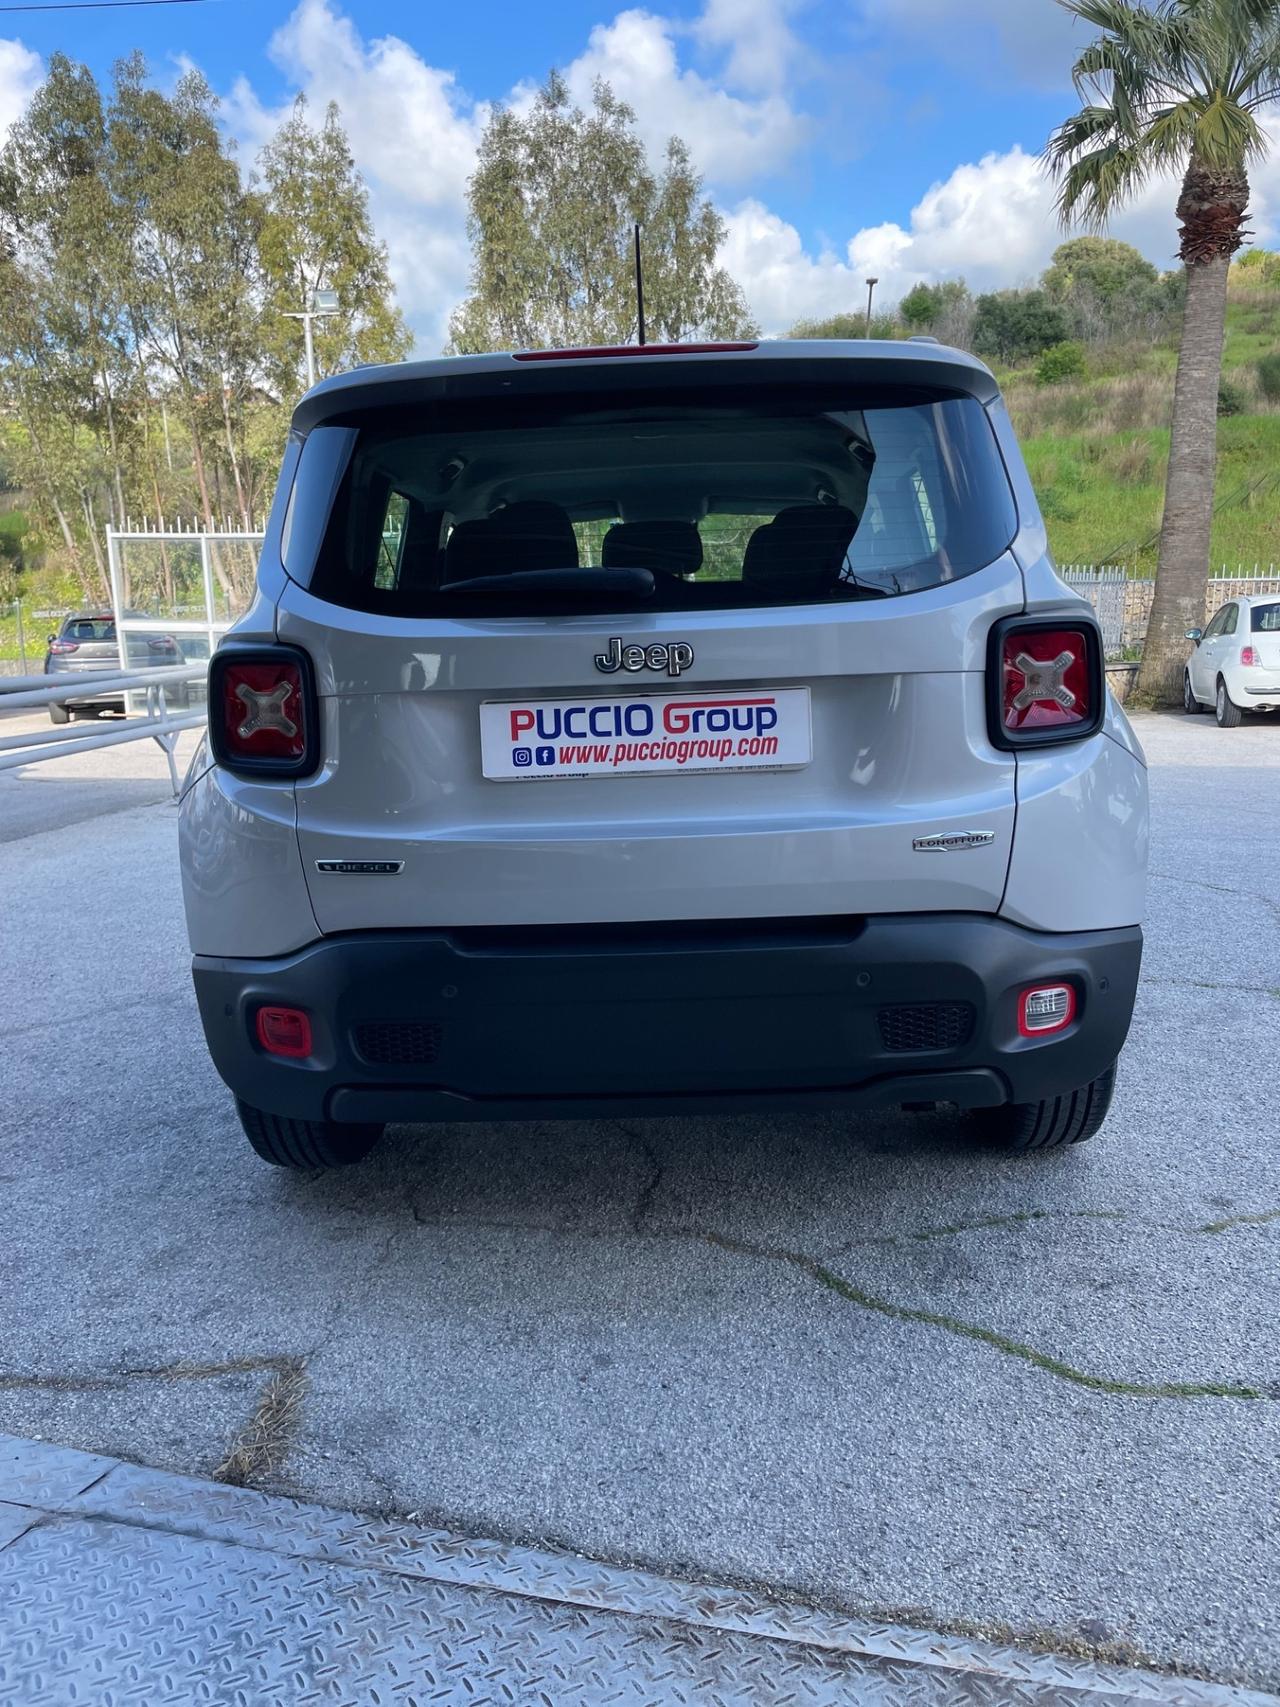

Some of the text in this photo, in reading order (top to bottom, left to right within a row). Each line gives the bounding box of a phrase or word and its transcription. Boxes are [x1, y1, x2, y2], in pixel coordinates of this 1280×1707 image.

[594, 637, 693, 676] Jeep
[510, 698, 778, 741] PUCCIO Group
[559, 736, 778, 766] www.pucciogroup.com
[919, 834, 992, 848] LONGITUDE
[335, 863, 397, 872] DIESEL
